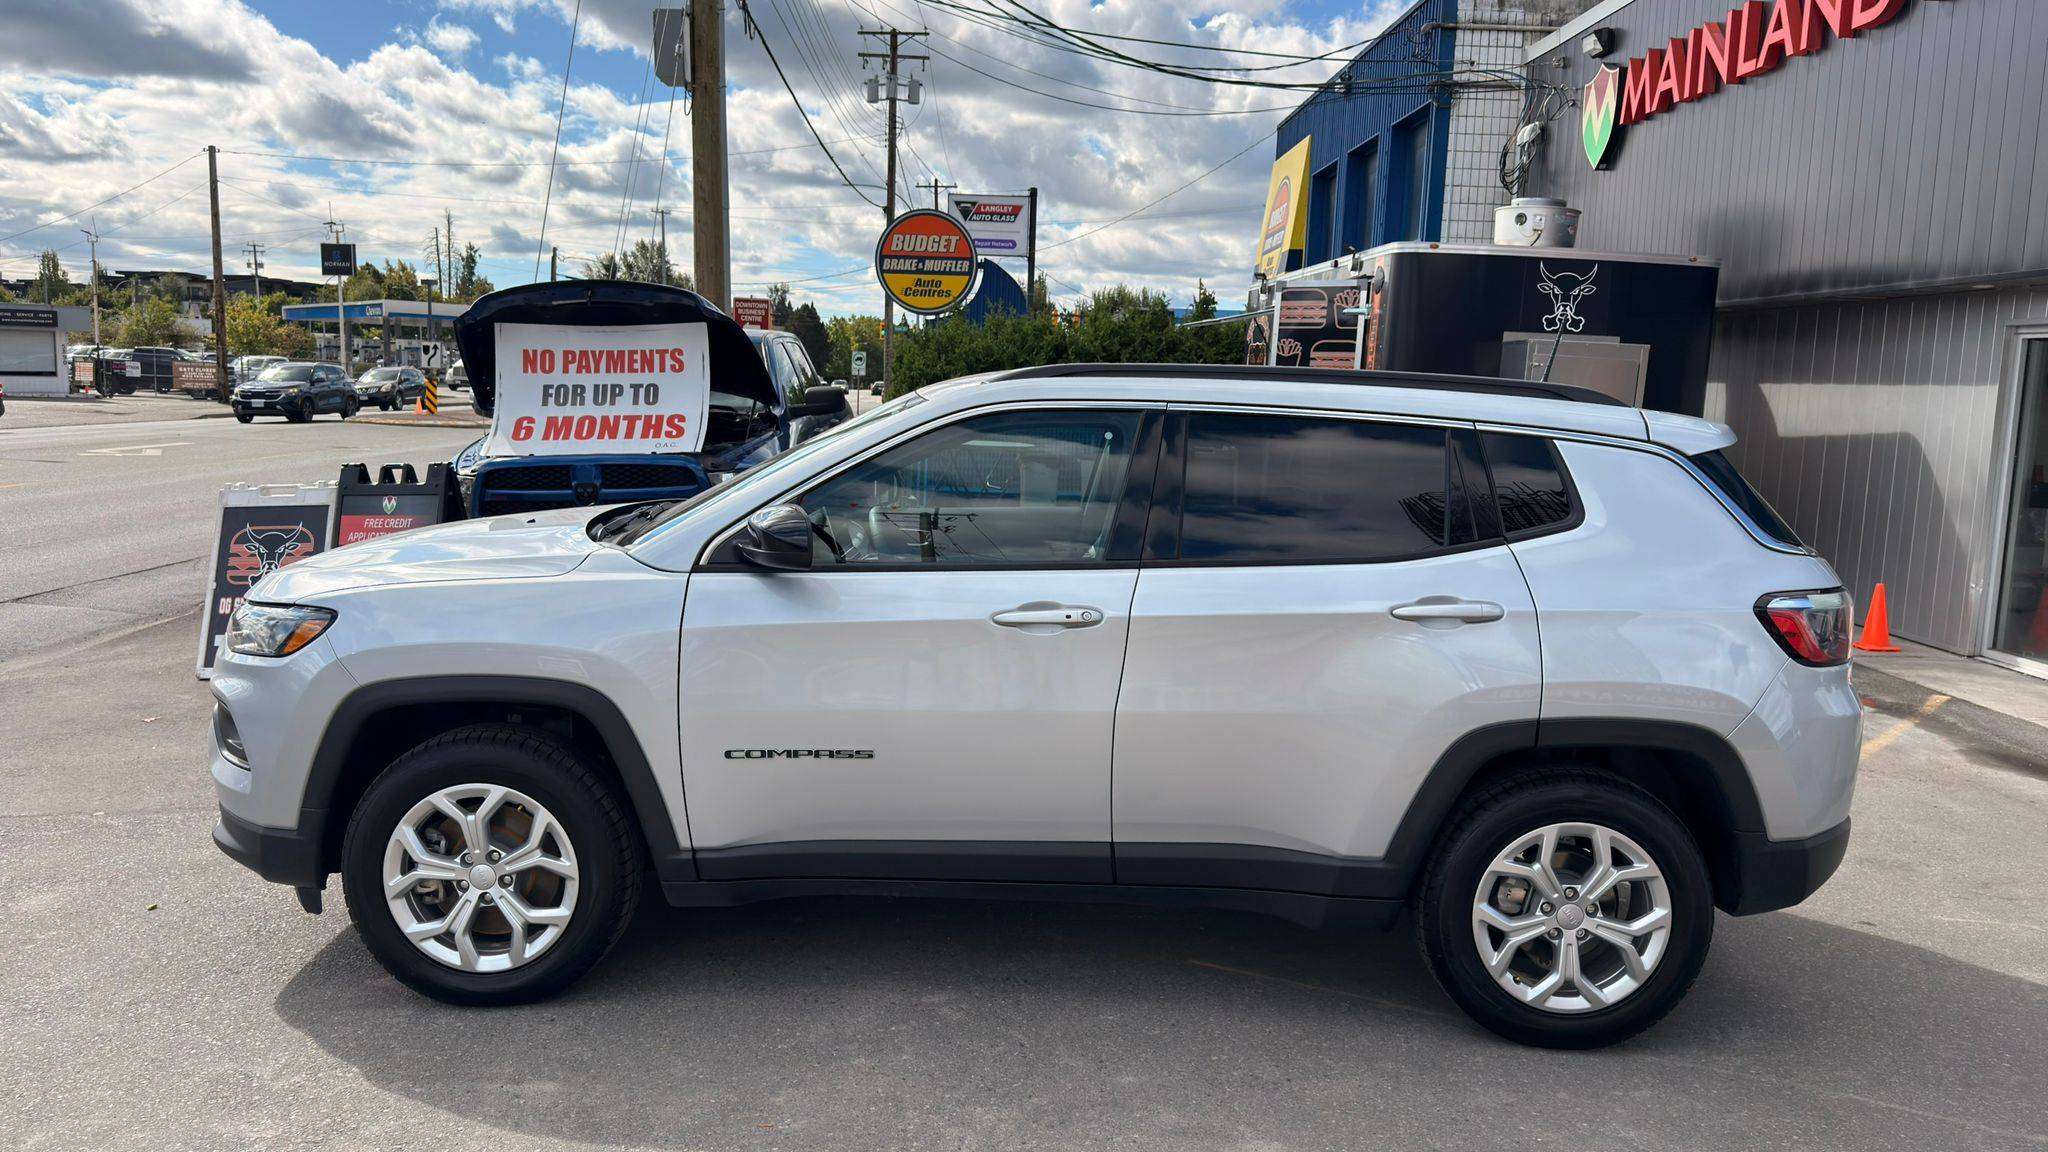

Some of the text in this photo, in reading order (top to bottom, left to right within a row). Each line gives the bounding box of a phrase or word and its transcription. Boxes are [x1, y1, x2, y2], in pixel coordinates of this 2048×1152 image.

[891, 234, 960, 253] BUDGET
[883, 258, 918, 271] BRAKE
[924, 259, 970, 272] MUFFLER
[914, 277, 942, 288] Auto
[903, 287, 952, 298] Centres
[736, 301, 768, 309] DOWNTOWN
[522, 347, 685, 374] NO PAYMENTS
[541, 383, 660, 407] FOR UP TO
[511, 413, 687, 442] 6 MONTHS
[364, 518, 413, 528] FREE CREDIT
[724, 749, 874, 759] COMPASS
